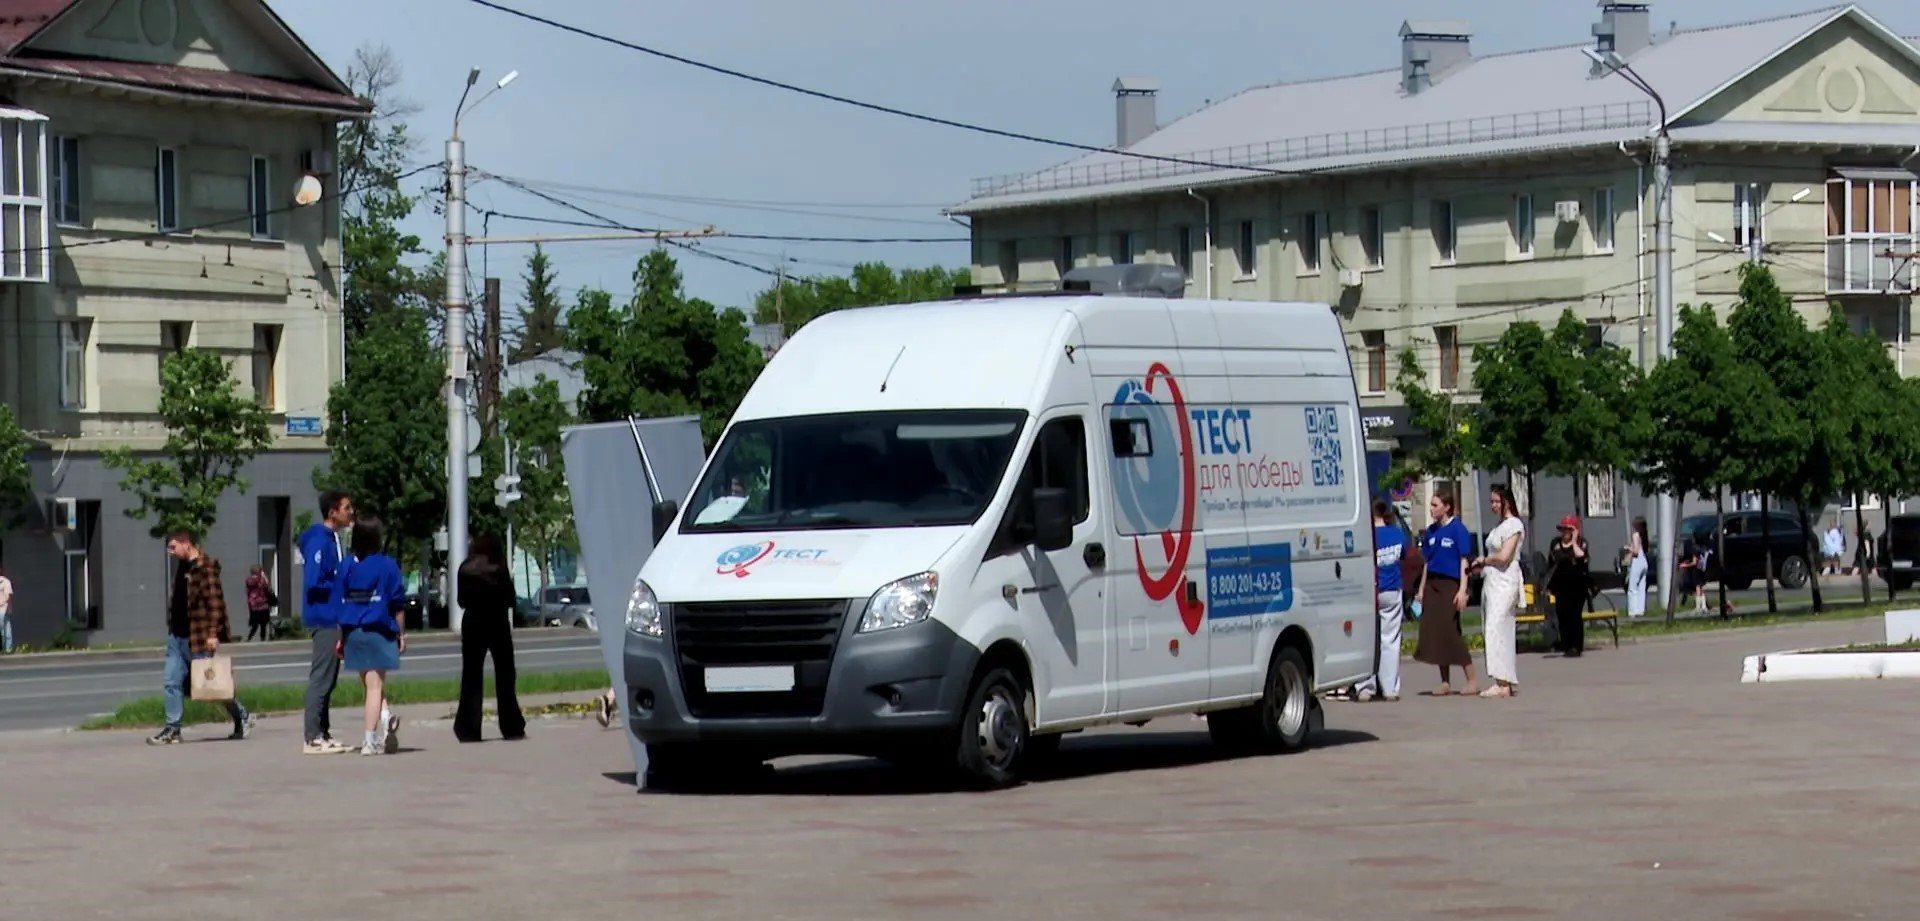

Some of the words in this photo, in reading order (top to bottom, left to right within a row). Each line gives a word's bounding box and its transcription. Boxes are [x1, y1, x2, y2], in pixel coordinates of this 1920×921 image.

[1191, 408, 1251, 455] ТЕСТ
[1200, 463, 1231, 495] для
[1237, 454, 1303, 492] победы
[773, 548, 828, 559] ТЕСТ
[1211, 575, 1218, 595] 8
[1219, 574, 1237, 595] 800
[1238, 571, 1282, 593] 201-43-25
